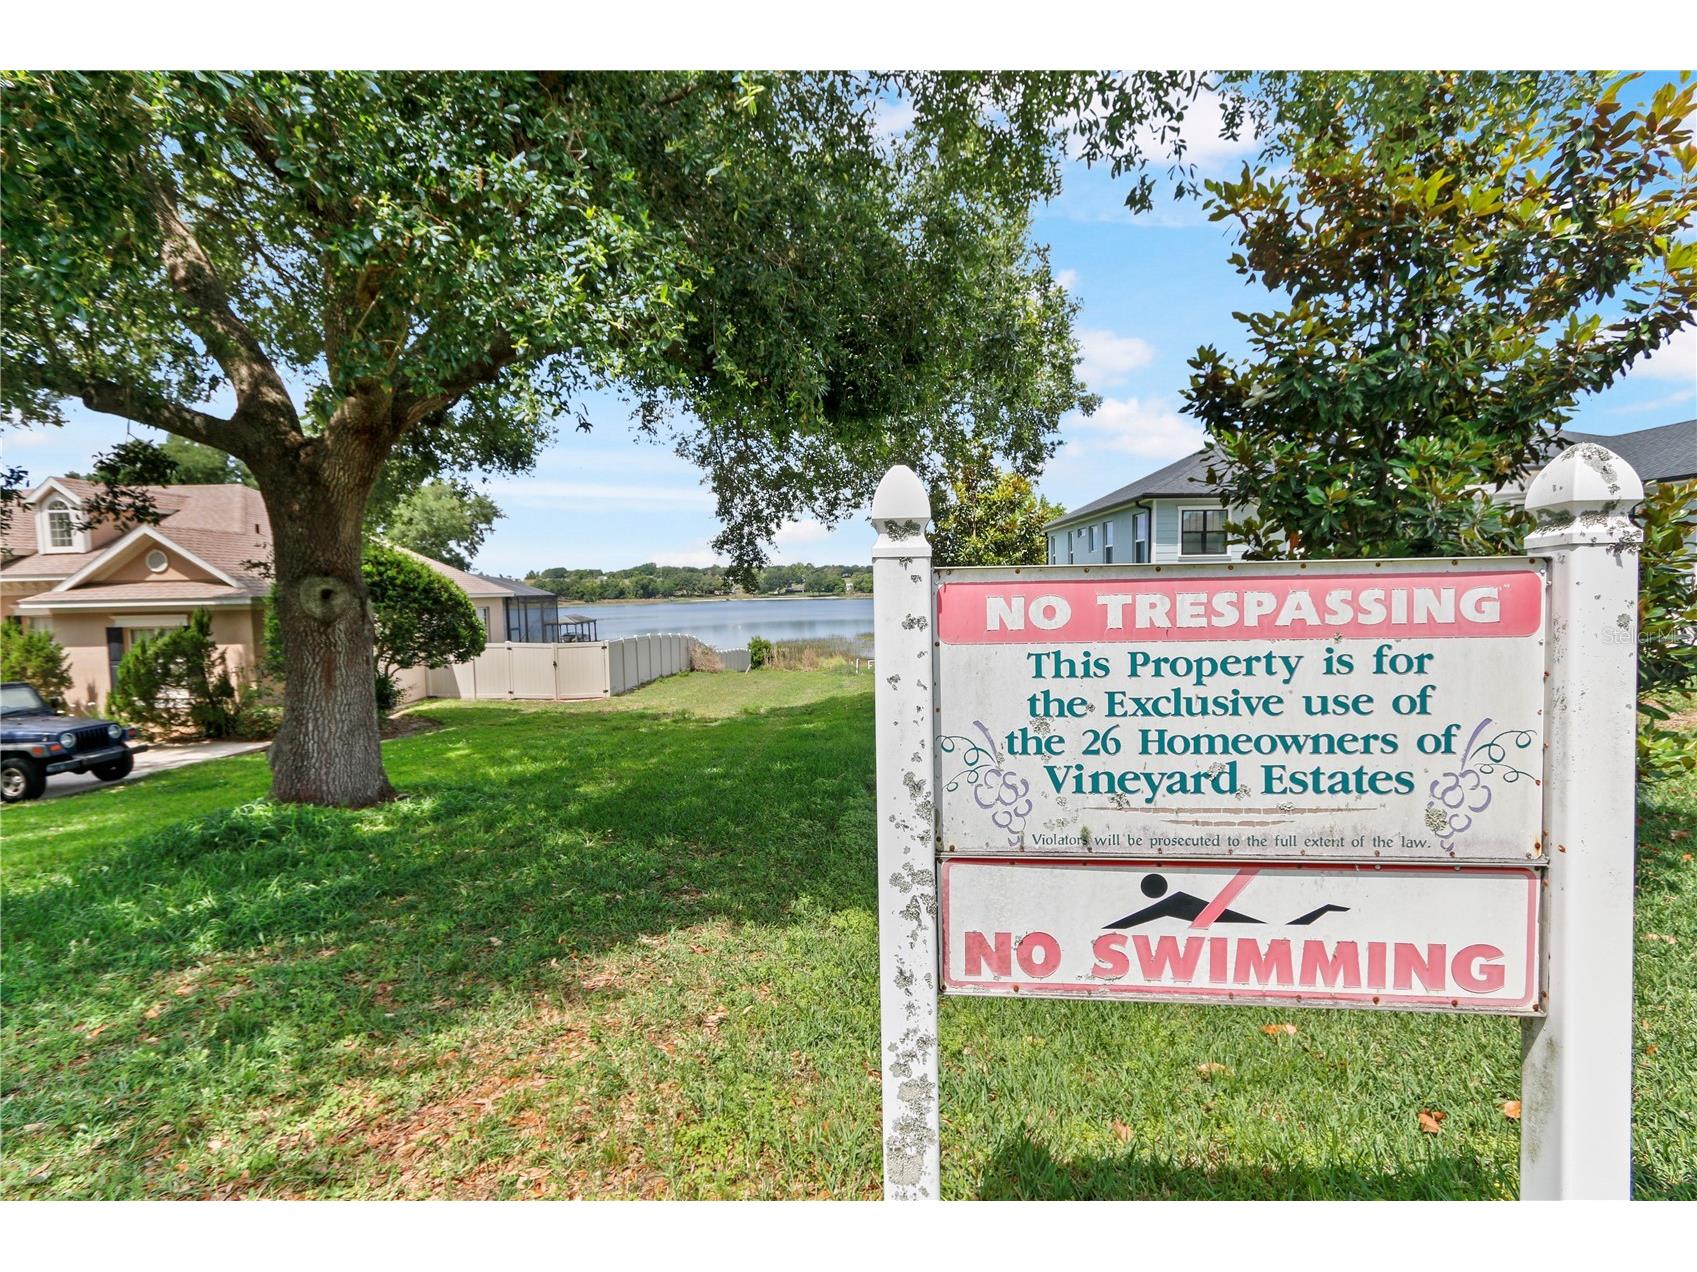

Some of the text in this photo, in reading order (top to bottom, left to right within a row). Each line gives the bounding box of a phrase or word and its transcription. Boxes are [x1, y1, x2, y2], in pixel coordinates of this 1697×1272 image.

[986, 586, 1501, 631] NO TRESPASSING
[1026, 644, 1434, 686] This Property is for
[1026, 683, 1437, 719] the Exclusive use of
[1004, 723, 1462, 757] the 26 Homeowners of
[1043, 760, 1416, 804] Vineyard Estates
[1031, 833, 1431, 849] Violators will be prosecuted to the full extent of the law.
[965, 931, 1506, 994] NO SWIMMING
